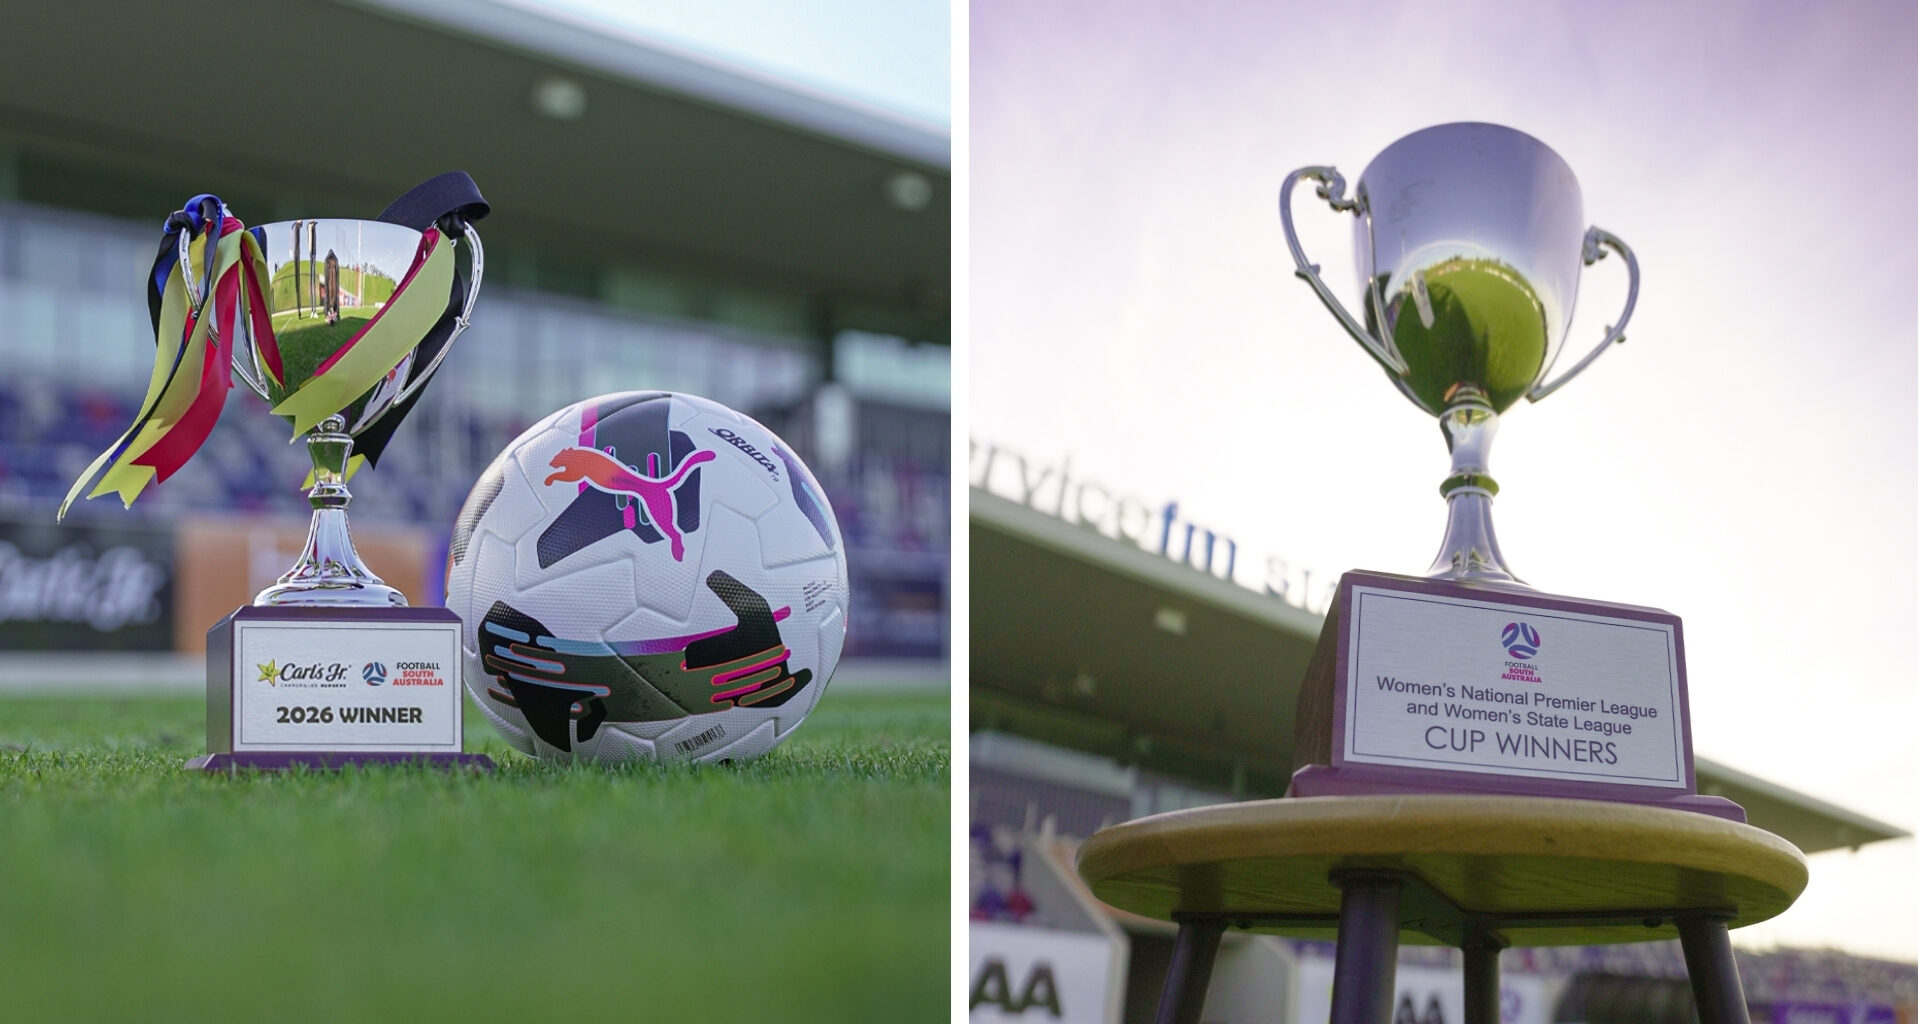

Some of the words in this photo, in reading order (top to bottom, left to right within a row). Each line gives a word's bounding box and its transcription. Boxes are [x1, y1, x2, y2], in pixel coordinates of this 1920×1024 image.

[708, 427, 779, 475] ORBITA
[969, 439, 1237, 582] rvicefm
[280, 662, 324, 681] Carl's
[325, 663, 348, 682] Jr.
[396, 662, 440, 670] FOOTBALL
[1504, 661, 1538, 671] FOOTBALL
[1508, 668, 1534, 677] SOUTH
[392, 677, 444, 686] AUSTRALIA
[1501, 673, 1542, 684] AUSTRALIA
[1376, 676, 1456, 699] Women's
[1461, 685, 1528, 706] National
[1534, 693, 1596, 712] Premier
[1601, 700, 1658, 720] League
[276, 706, 334, 724] 2026
[338, 707, 423, 724] WINNER
[1406, 701, 1438, 716] and
[1444, 703, 1521, 725] Women's
[1527, 711, 1569, 729] State
[1573, 717, 1632, 736] League
[1425, 725, 1486, 753] CUP
[1495, 732, 1618, 765] WINNERS
